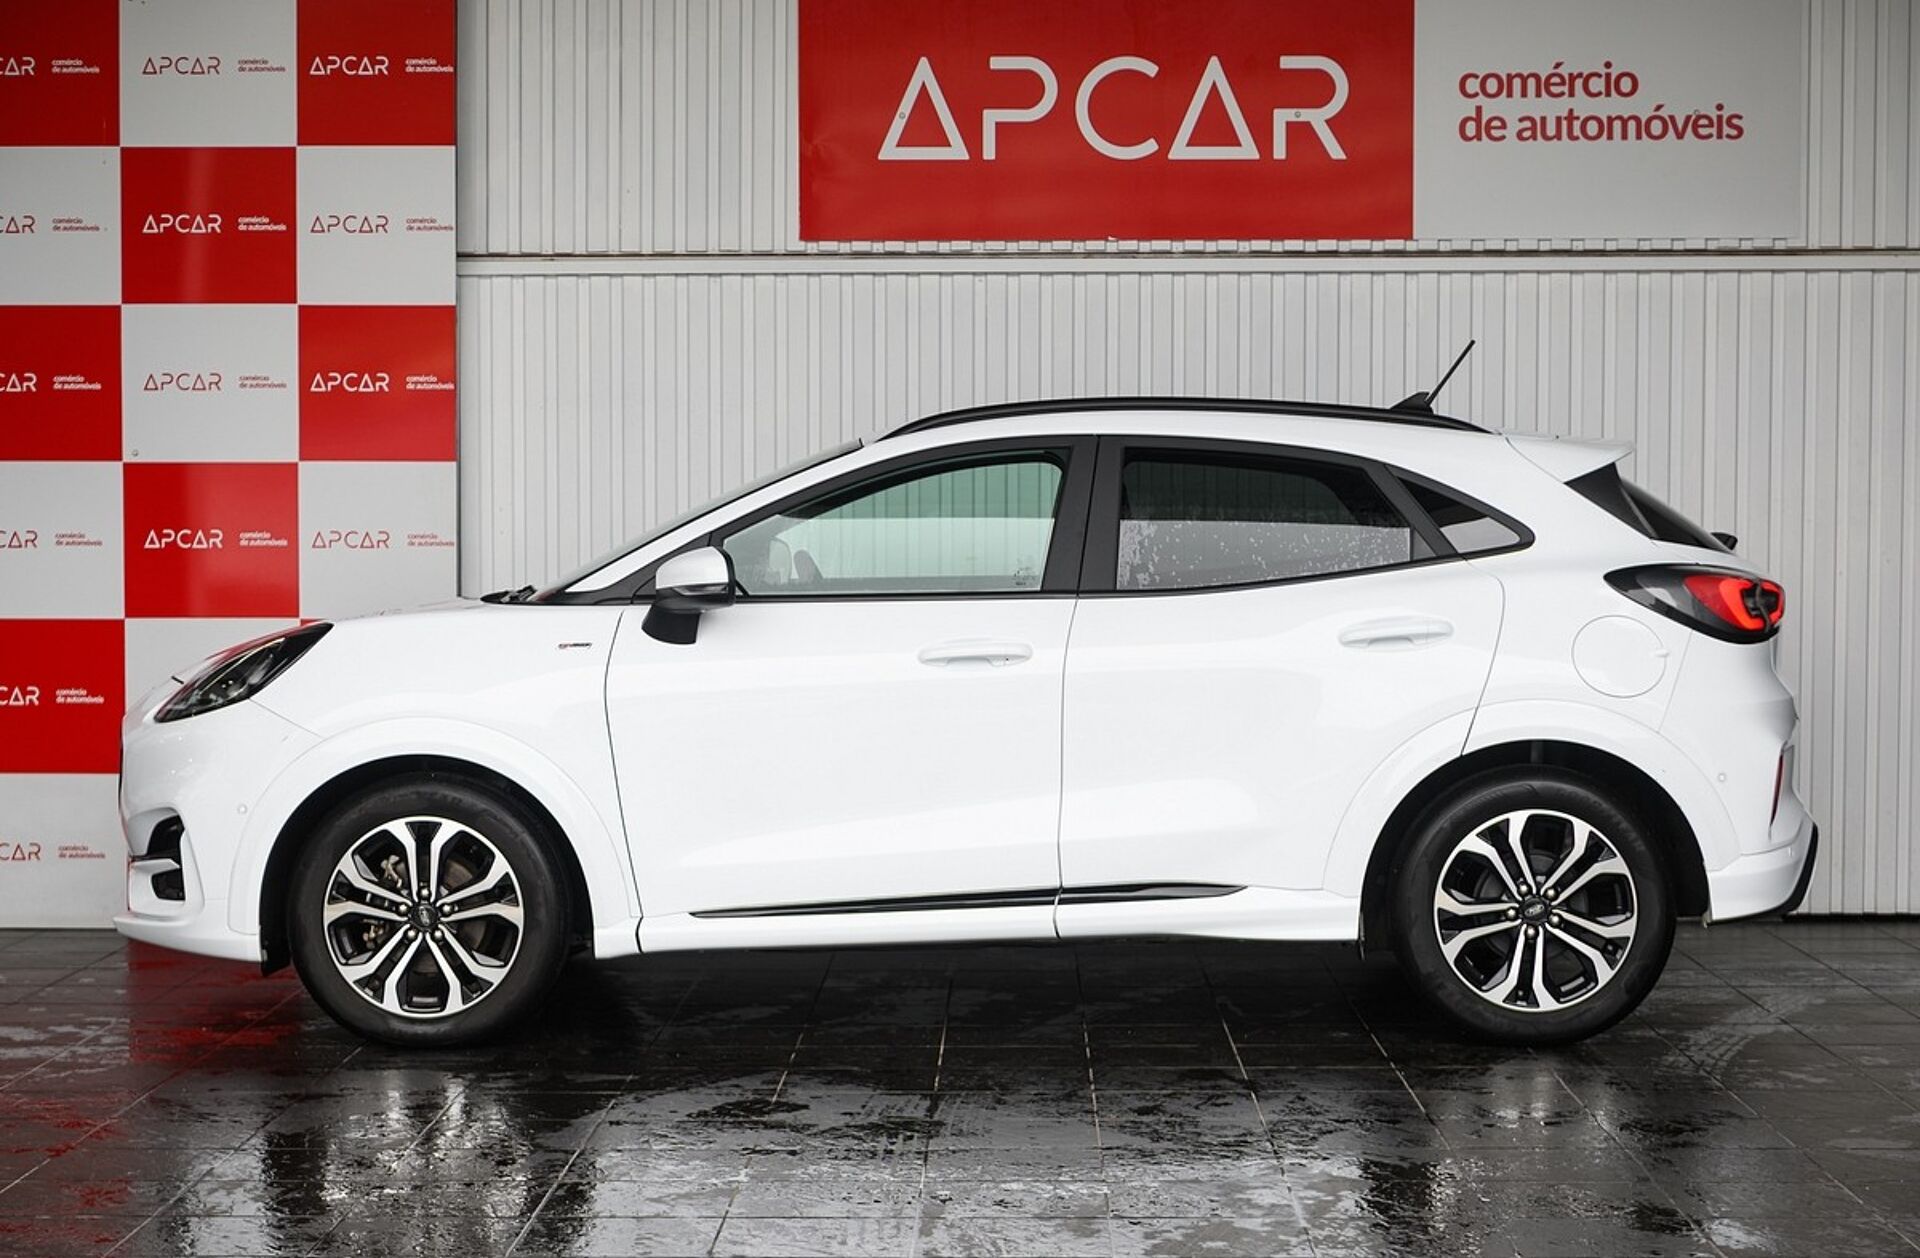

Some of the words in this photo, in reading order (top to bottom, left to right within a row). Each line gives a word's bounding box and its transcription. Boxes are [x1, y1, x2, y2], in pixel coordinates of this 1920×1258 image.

[142, 57, 221, 75] APCAR
[310, 56, 389, 75] APCAR
[1459, 61, 1639, 99] comércio
[878, 56, 1349, 161] APCAR
[1459, 104, 1507, 142] de
[1517, 103, 1745, 142] automóveis
[142, 214, 221, 233] APCAR
[311, 215, 388, 233] APCAR
[144, 373, 222, 391] APCAR
[311, 373, 389, 392] APCAR
[144, 529, 223, 548] APCAR
[312, 531, 390, 548] APCAR
[0, 843, 41, 861] CAR
